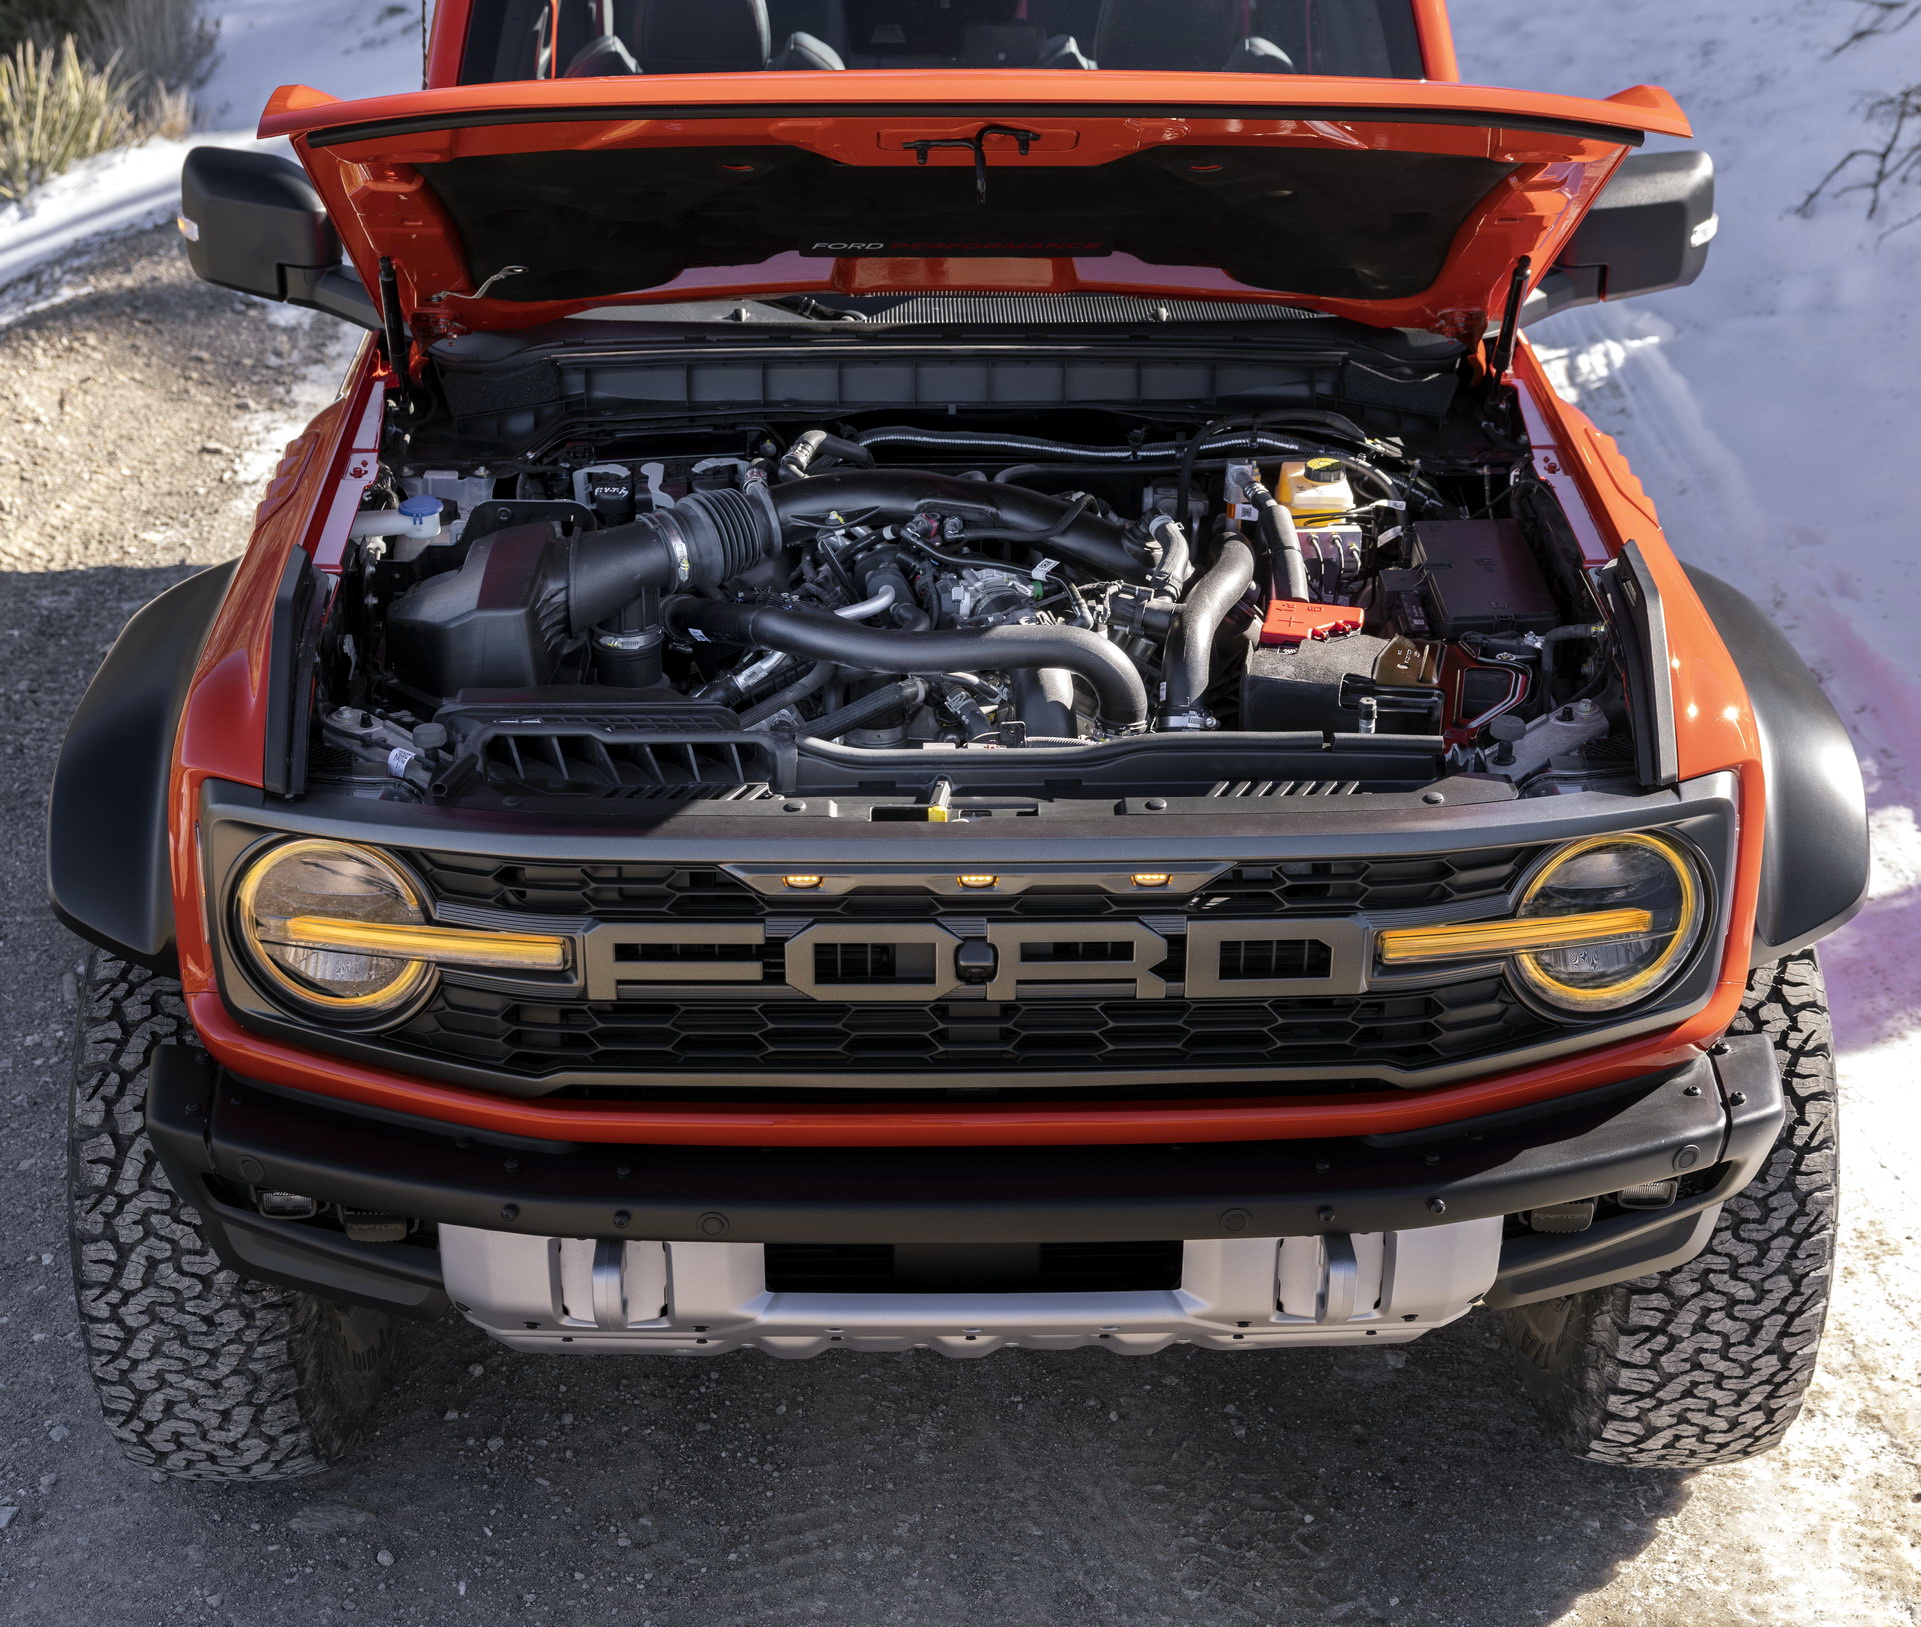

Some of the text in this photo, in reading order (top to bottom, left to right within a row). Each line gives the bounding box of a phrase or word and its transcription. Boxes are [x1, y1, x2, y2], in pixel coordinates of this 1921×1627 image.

[811, 242, 1103, 250] FORD PERFORMANCE
[585, 918, 1369, 1001] FORD
[1534, 1212, 1590, 1220] RAPTOR
